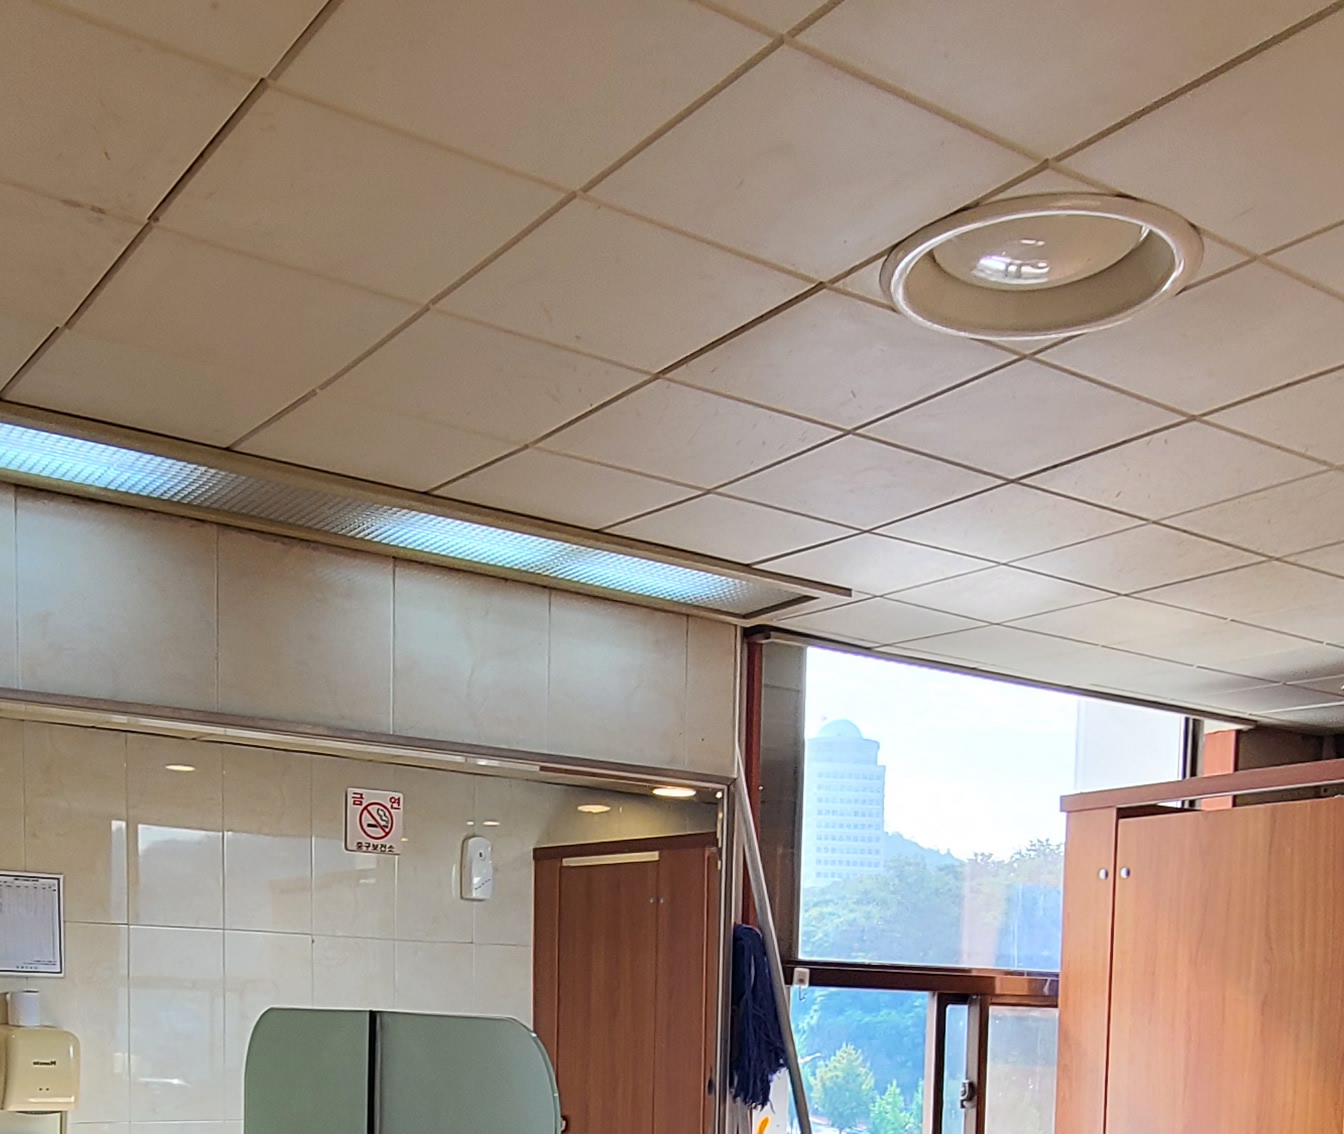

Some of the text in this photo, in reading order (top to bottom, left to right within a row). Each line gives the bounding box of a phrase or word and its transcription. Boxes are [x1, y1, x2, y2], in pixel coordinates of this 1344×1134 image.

[351, 792, 401, 810] 금 연
[356, 841, 395, 852] 중구보건소
